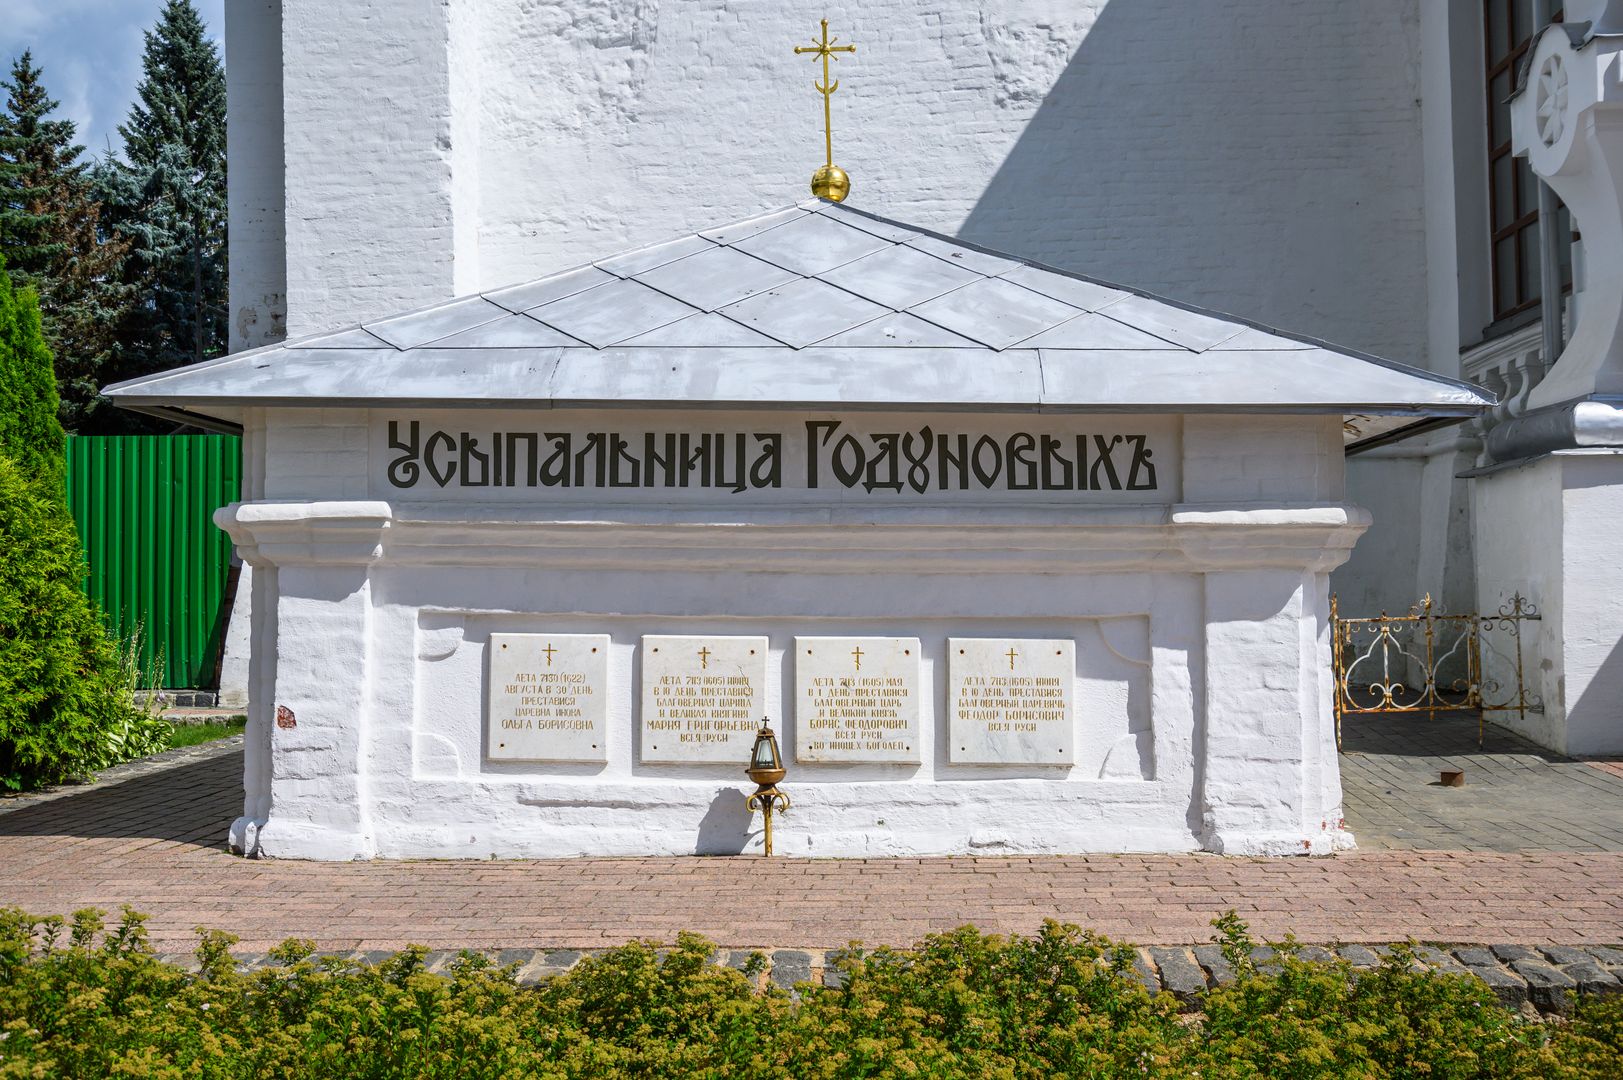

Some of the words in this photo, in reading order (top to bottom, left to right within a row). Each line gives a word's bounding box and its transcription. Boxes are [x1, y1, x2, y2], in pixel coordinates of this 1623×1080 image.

[516, 673, 536, 682] ЛЕТА
[660, 676, 681, 685] ЛЕТА
[727, 676, 749, 685] ИЮНЯ
[813, 678, 834, 686] ЛЕТА
[886, 678, 903, 686] МАЯ
[964, 677, 985, 686] ЛЕТА
[1036, 677, 1059, 686] ИЮНЯ
[505, 685, 543, 694] АВГУСТА
[546, 685, 551, 694] В
[556, 685, 566, 694] 30
[571, 685, 592, 694] ДЕНЬ
[654, 687, 659, 696] В
[663, 687, 670, 696] 10
[675, 687, 696, 696] ДЕНЬ
[702, 687, 753, 696] ПРЕСТАВИСЯ
[962, 688, 967, 697] В
[972, 688, 978, 697] 10
[983, 688, 1004, 697] ДЕНЬ
[1009, 688, 1062, 697] ПРЕСТАВИСЯ
[522, 697, 575, 705] ПРЕСТАВИСЯ
[657, 698, 714, 707] БЛАГОВЕРНАЯ
[720, 698, 752, 707] ЦАРИЦА
[881, 699, 902, 707] ЦАРЬ
[659, 709, 664, 718] И
[670, 709, 707, 718] ВЕЛИКАЯ
[712, 709, 748, 718] КНЯГИНЯ
[820, 709, 824, 717] И
[871, 709, 897, 717] КНЯЗЬ
[959, 711, 999, 720] ФЕОДОР
[1005, 711, 1064, 720] БОРИСОВИЧ
[502, 720, 532, 730] ОЛЬГА
[539, 720, 594, 730] БОРИСОВНА
[647, 721, 680, 730] МАРИЯ
[688, 721, 760, 730] ГРИГОРЬЕВНА
[810, 720, 840, 729] БОРИС
[845, 720, 907, 729] ФЕОДОРОВИЧ
[988, 723, 1009, 731] ВСЕЯ
[1015, 723, 1036, 731] РУСИ
[681, 734, 701, 742] ВСЕЯ
[706, 734, 728, 742] РУСИ
[814, 742, 824, 750] ВО
[830, 742, 860, 750] ИНОЦЕХ
[867, 742, 904, 750] БОГОЛЕП
